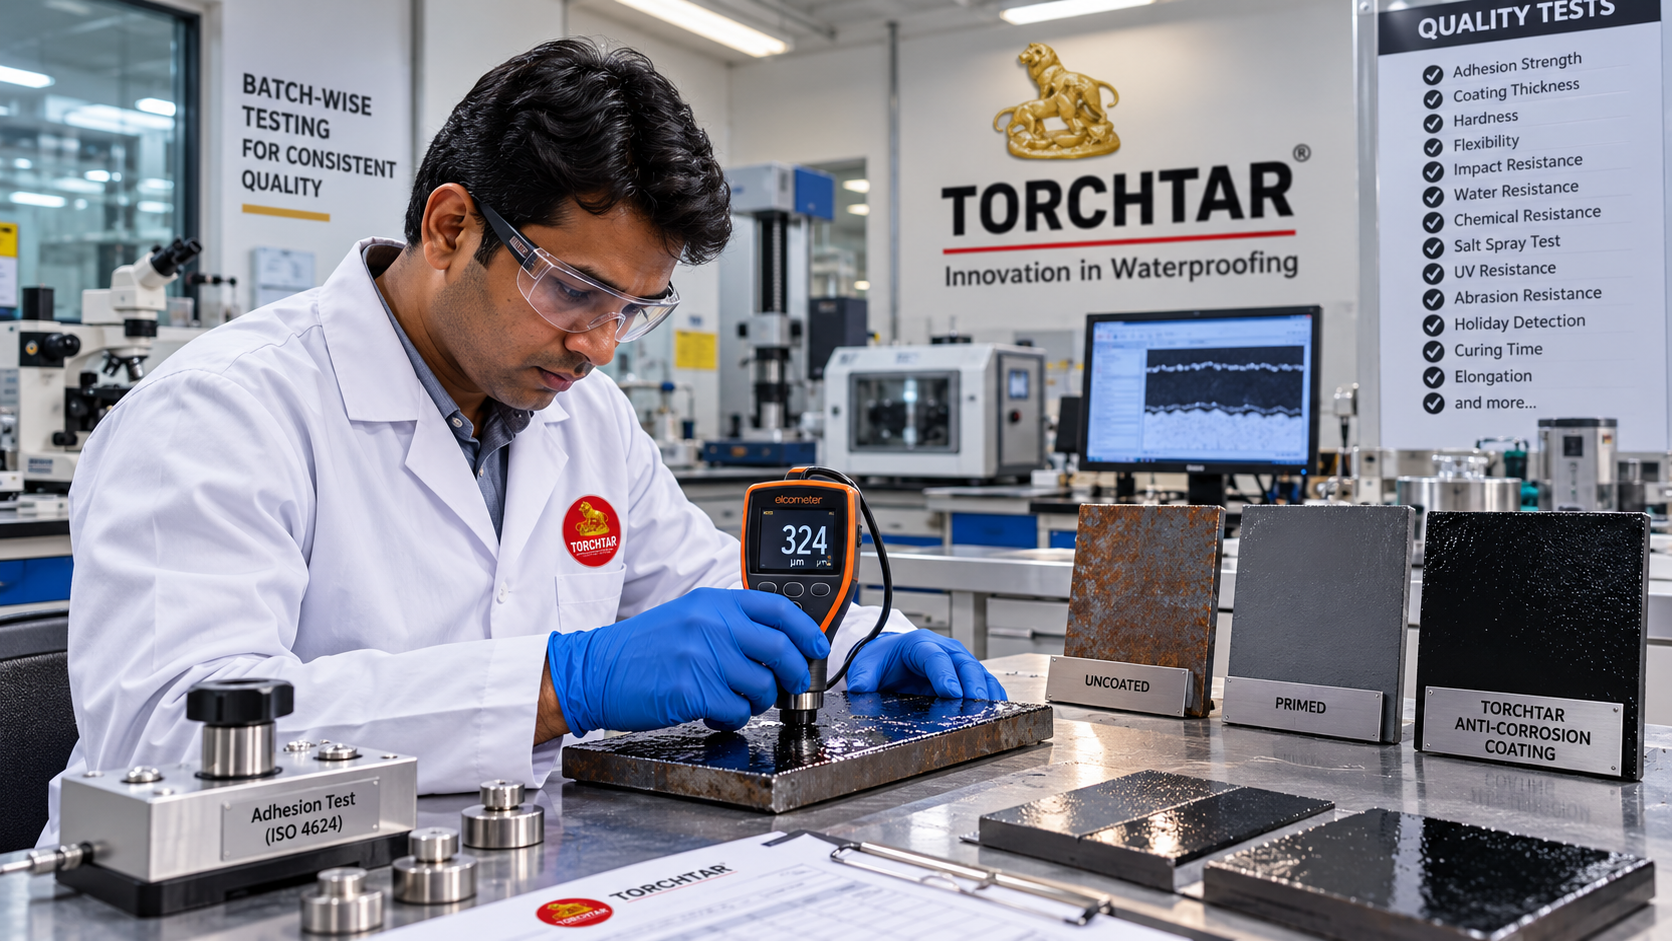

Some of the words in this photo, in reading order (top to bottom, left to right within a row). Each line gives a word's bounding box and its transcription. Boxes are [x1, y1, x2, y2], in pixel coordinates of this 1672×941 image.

[1418, 5, 1530, 40] QUALITY
[1537, 0, 1615, 23] TESTS
[1453, 60, 1517, 78] Adhesion
[1521, 51, 1582, 70] Strength
[243, 73, 371, 116] BATCH-WISE
[1454, 87, 1507, 102] Coating
[1511, 79, 1580, 96] Thickness
[242, 105, 330, 139] TESTING
[1454, 111, 1518, 127] Hardness
[1454, 134, 1520, 151] Flexibility
[243, 138, 280, 162] FOR
[286, 146, 397, 178] CONSISTENT
[1454, 160, 1502, 177] Impact
[1507, 154, 1583, 171] Resistance
[242, 170, 322, 197] QUALITY
[1454, 187, 1497, 201] Water
[1502, 181, 1579, 197] Resistance
[941, 161, 1294, 236] TORCHTAR
[1454, 210, 1519, 226] Chemical
[1523, 206, 1601, 222] Resistance
[1454, 239, 1481, 252] Salt
[1485, 237, 1527, 253] Spray
[1531, 234, 1561, 248] Test
[946, 262, 1070, 286] Innovation
[1080, 259, 1101, 281] in
[1112, 250, 1298, 283] Waterproofing
[1454, 265, 1475, 278] UV
[1480, 262, 1556, 277] Resistance
[1454, 290, 1518, 304] Abrasion
[1523, 287, 1602, 302] Resistance
[1454, 316, 1509, 332] Holiday
[1513, 314, 1586, 329] Detection
[1454, 343, 1502, 359] Curing
[1507, 342, 1543, 356] Time
[1455, 369, 1532, 385] Elongation
[1455, 396, 1481, 409] and
[1487, 397, 1536, 409] more...
[775, 495, 822, 504] elcometer
[570, 535, 617, 553] TORCHTAR
[781, 525, 827, 554] 324
[1085, 674, 1150, 693] UNCOATED
[1275, 697, 1326, 714] PRIMED
[1481, 700, 1565, 722] TORCHTAR
[1455, 717, 1590, 745] ANTI-CORROSION
[1485, 740, 1556, 761] COATING
[251, 799, 322, 823] Adhesion
[326, 792, 356, 809] Test
[265, 824, 297, 846] (ISO
[301, 815, 343, 836] 4624)
[609, 864, 733, 901] TORCHTAR
